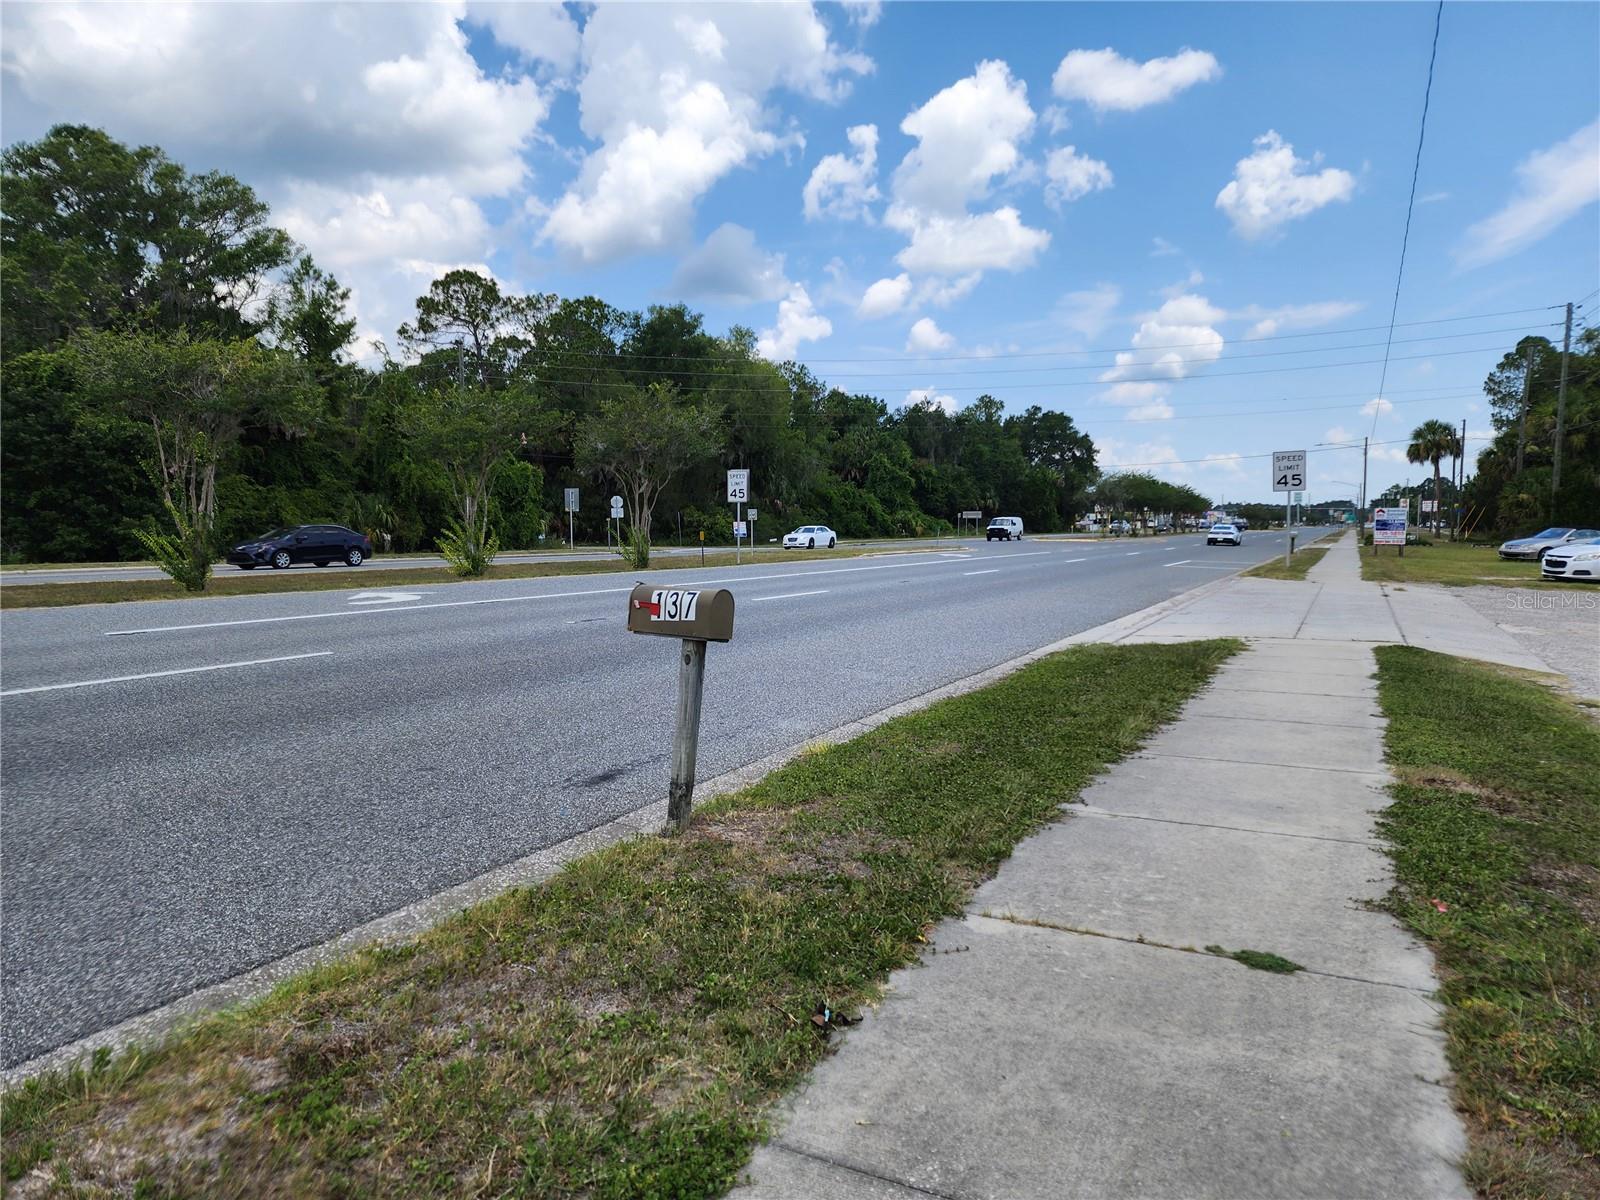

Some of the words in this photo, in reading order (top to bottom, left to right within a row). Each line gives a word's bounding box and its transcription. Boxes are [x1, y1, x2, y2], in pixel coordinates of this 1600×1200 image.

[1276, 474, 1302, 487] 45
[729, 488, 745, 499] 45
[656, 591, 697, 619] 137
